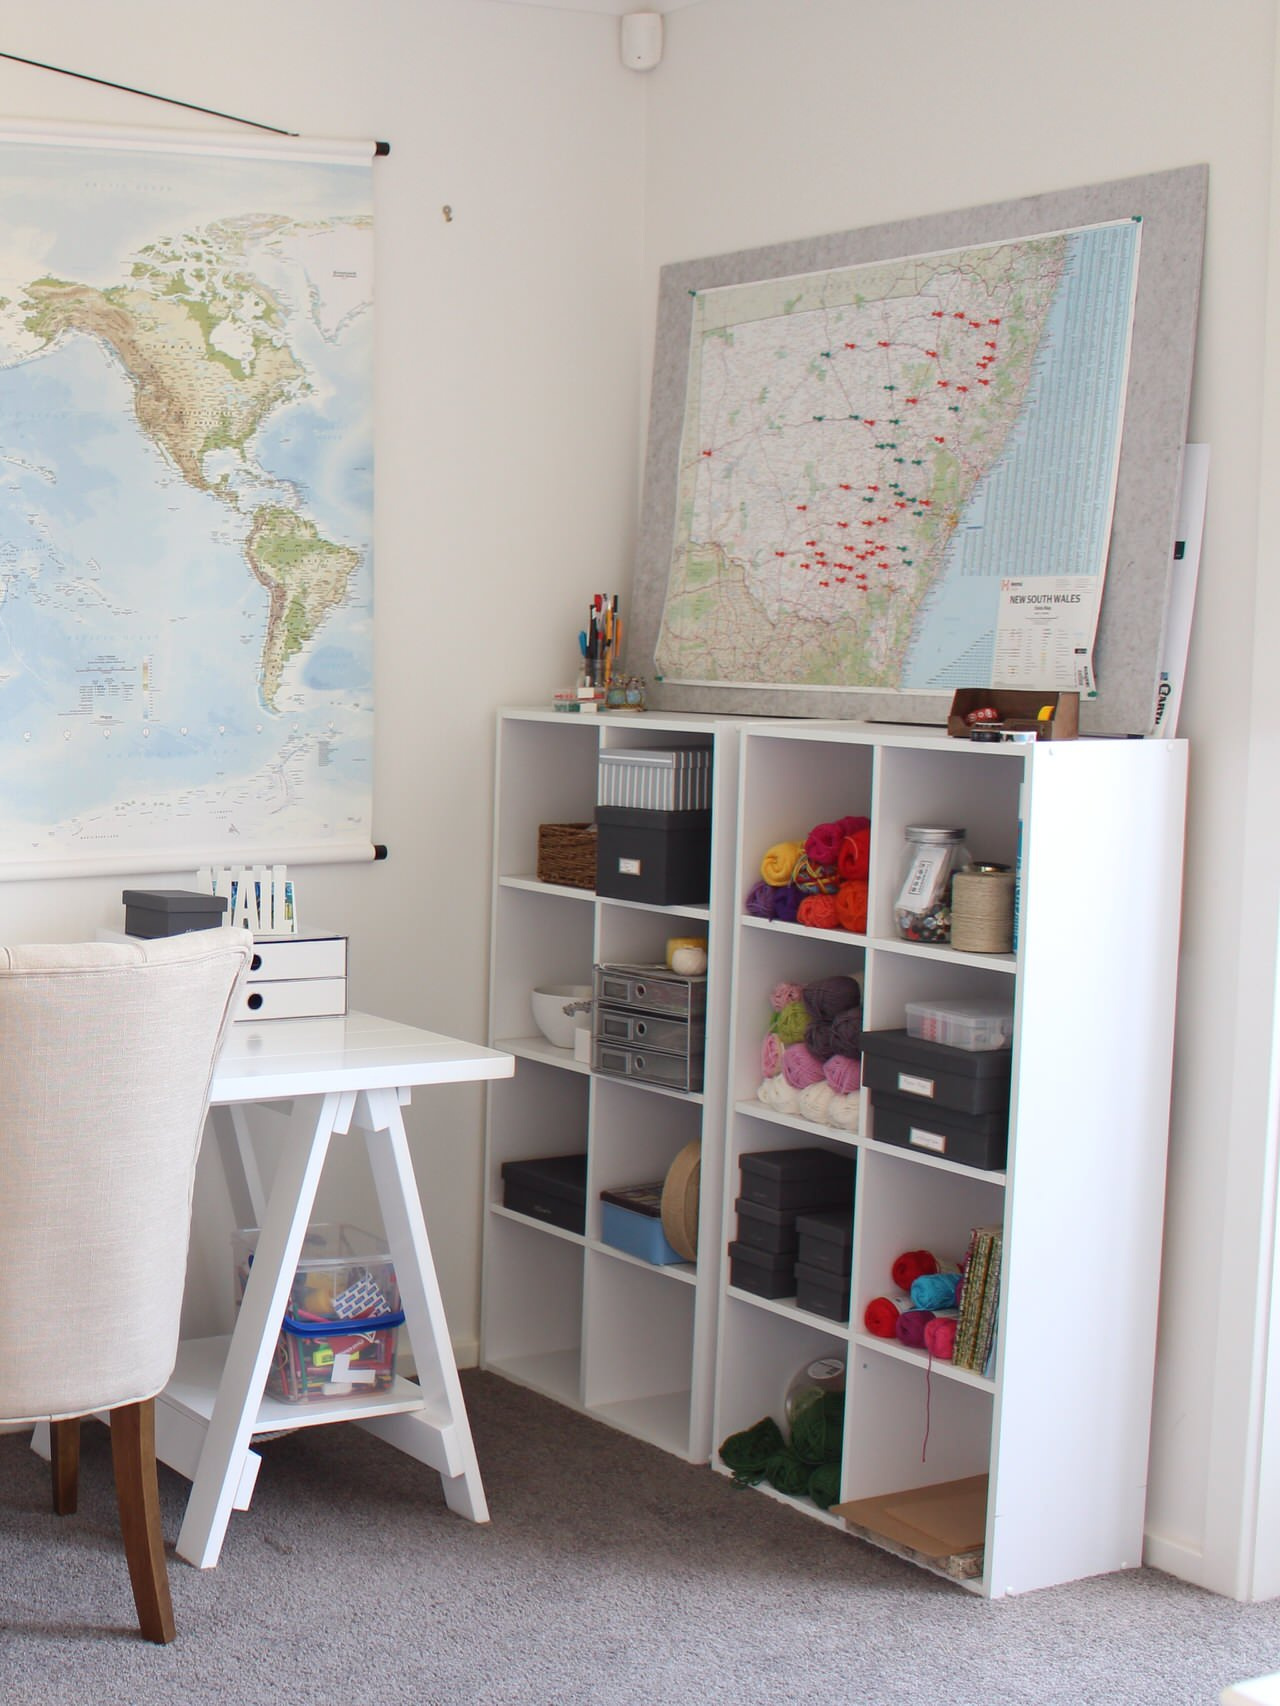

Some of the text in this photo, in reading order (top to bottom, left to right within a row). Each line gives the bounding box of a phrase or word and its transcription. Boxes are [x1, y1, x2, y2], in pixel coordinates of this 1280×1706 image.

[1009, 594, 1081, 604] NEW SOUTH WALES
